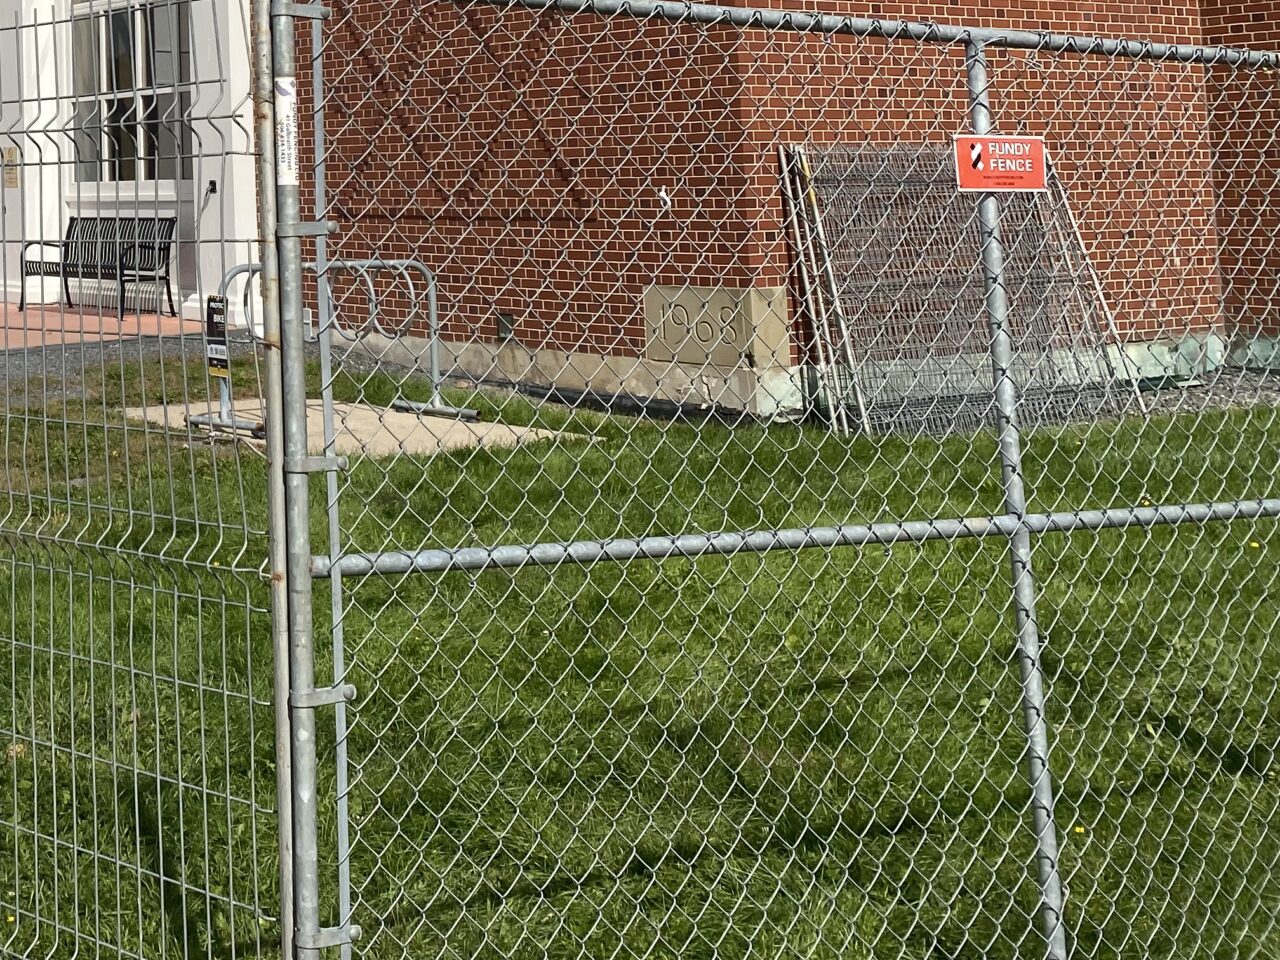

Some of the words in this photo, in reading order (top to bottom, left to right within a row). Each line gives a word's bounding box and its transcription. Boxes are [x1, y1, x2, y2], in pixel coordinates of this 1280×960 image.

[988, 142, 1031, 155] FUNDY
[990, 159, 1033, 172] FENCE
[660, 303, 738, 346] 1968
